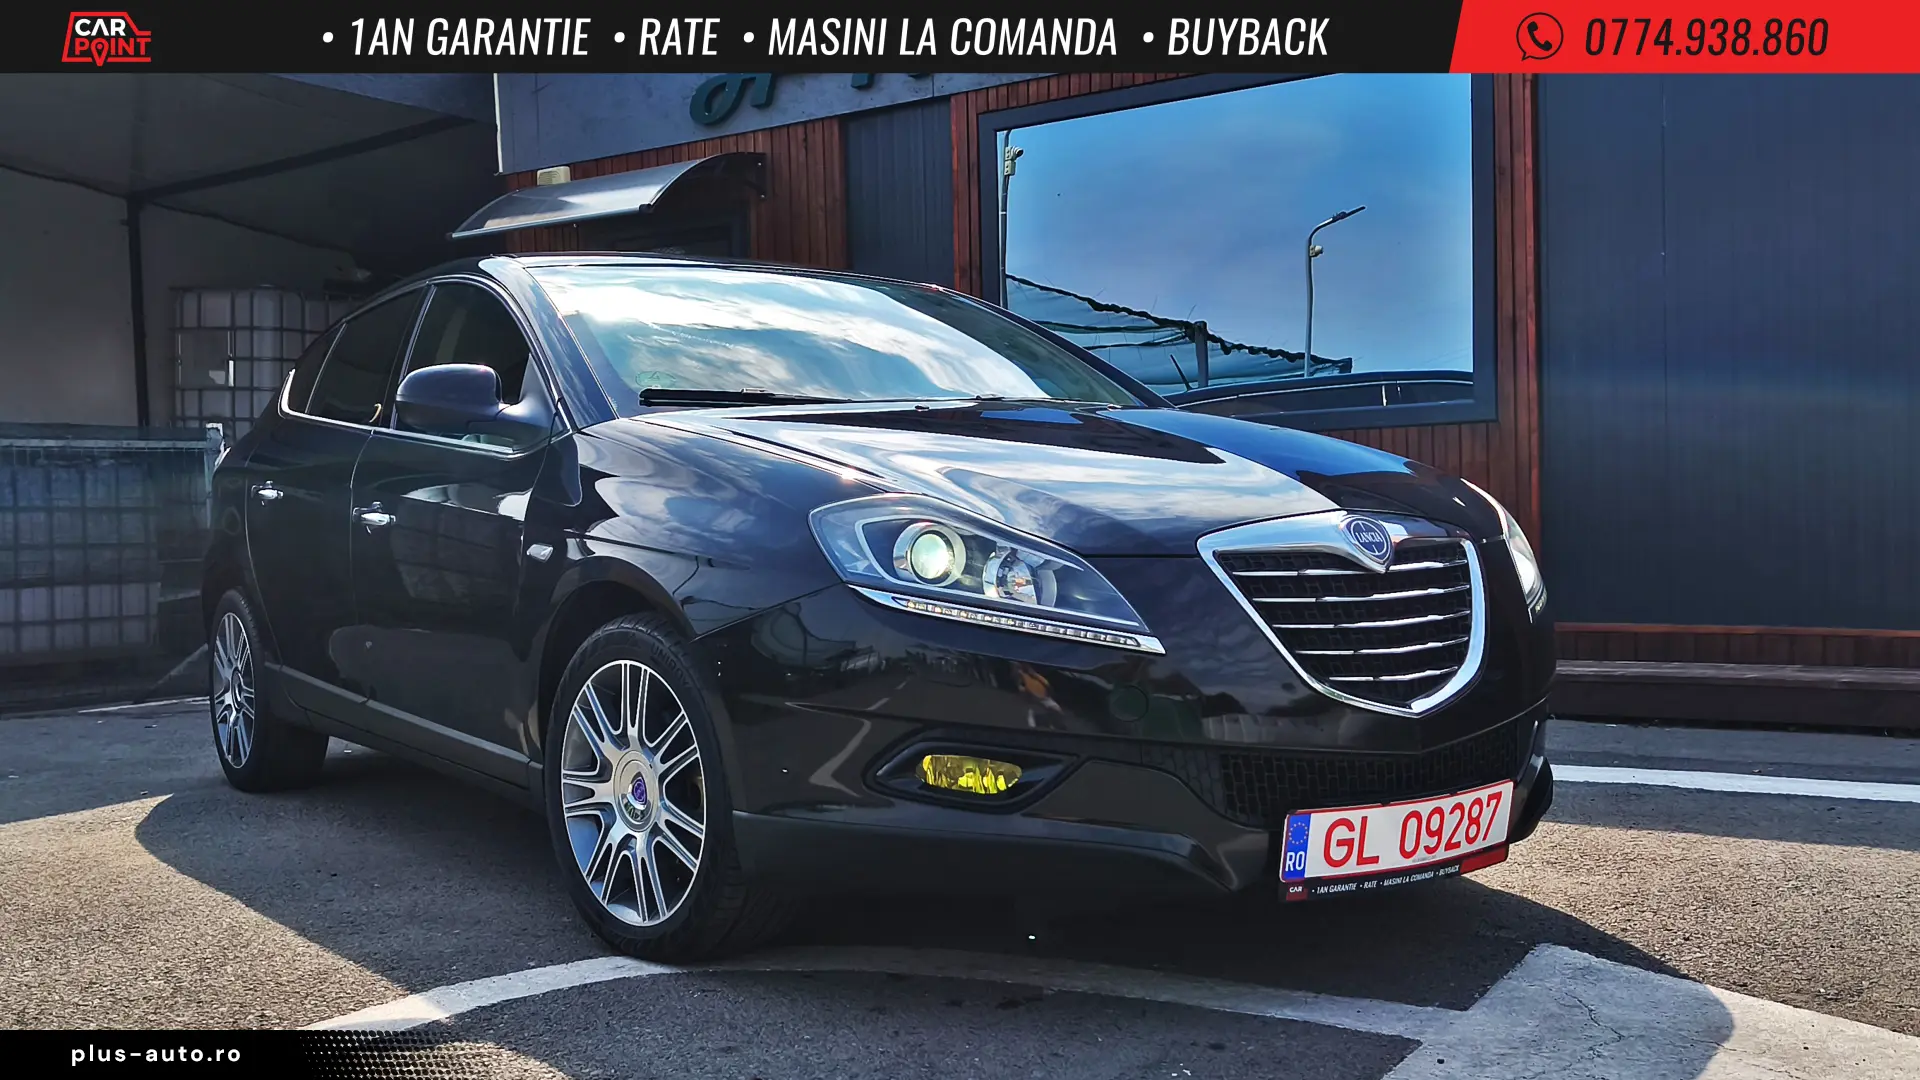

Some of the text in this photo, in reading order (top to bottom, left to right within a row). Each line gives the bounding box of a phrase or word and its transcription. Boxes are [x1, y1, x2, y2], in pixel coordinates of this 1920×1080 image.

[1355, 531, 1383, 543] LANCIA
[1323, 791, 1503, 868] GL 09287
[1285, 851, 1305, 872] RO
[1329, 882, 1357, 893] GARANTIE
[1363, 880, 1378, 889] RATE
[1402, 875, 1409, 884] LA
[1410, 871, 1434, 882] COMANDA
